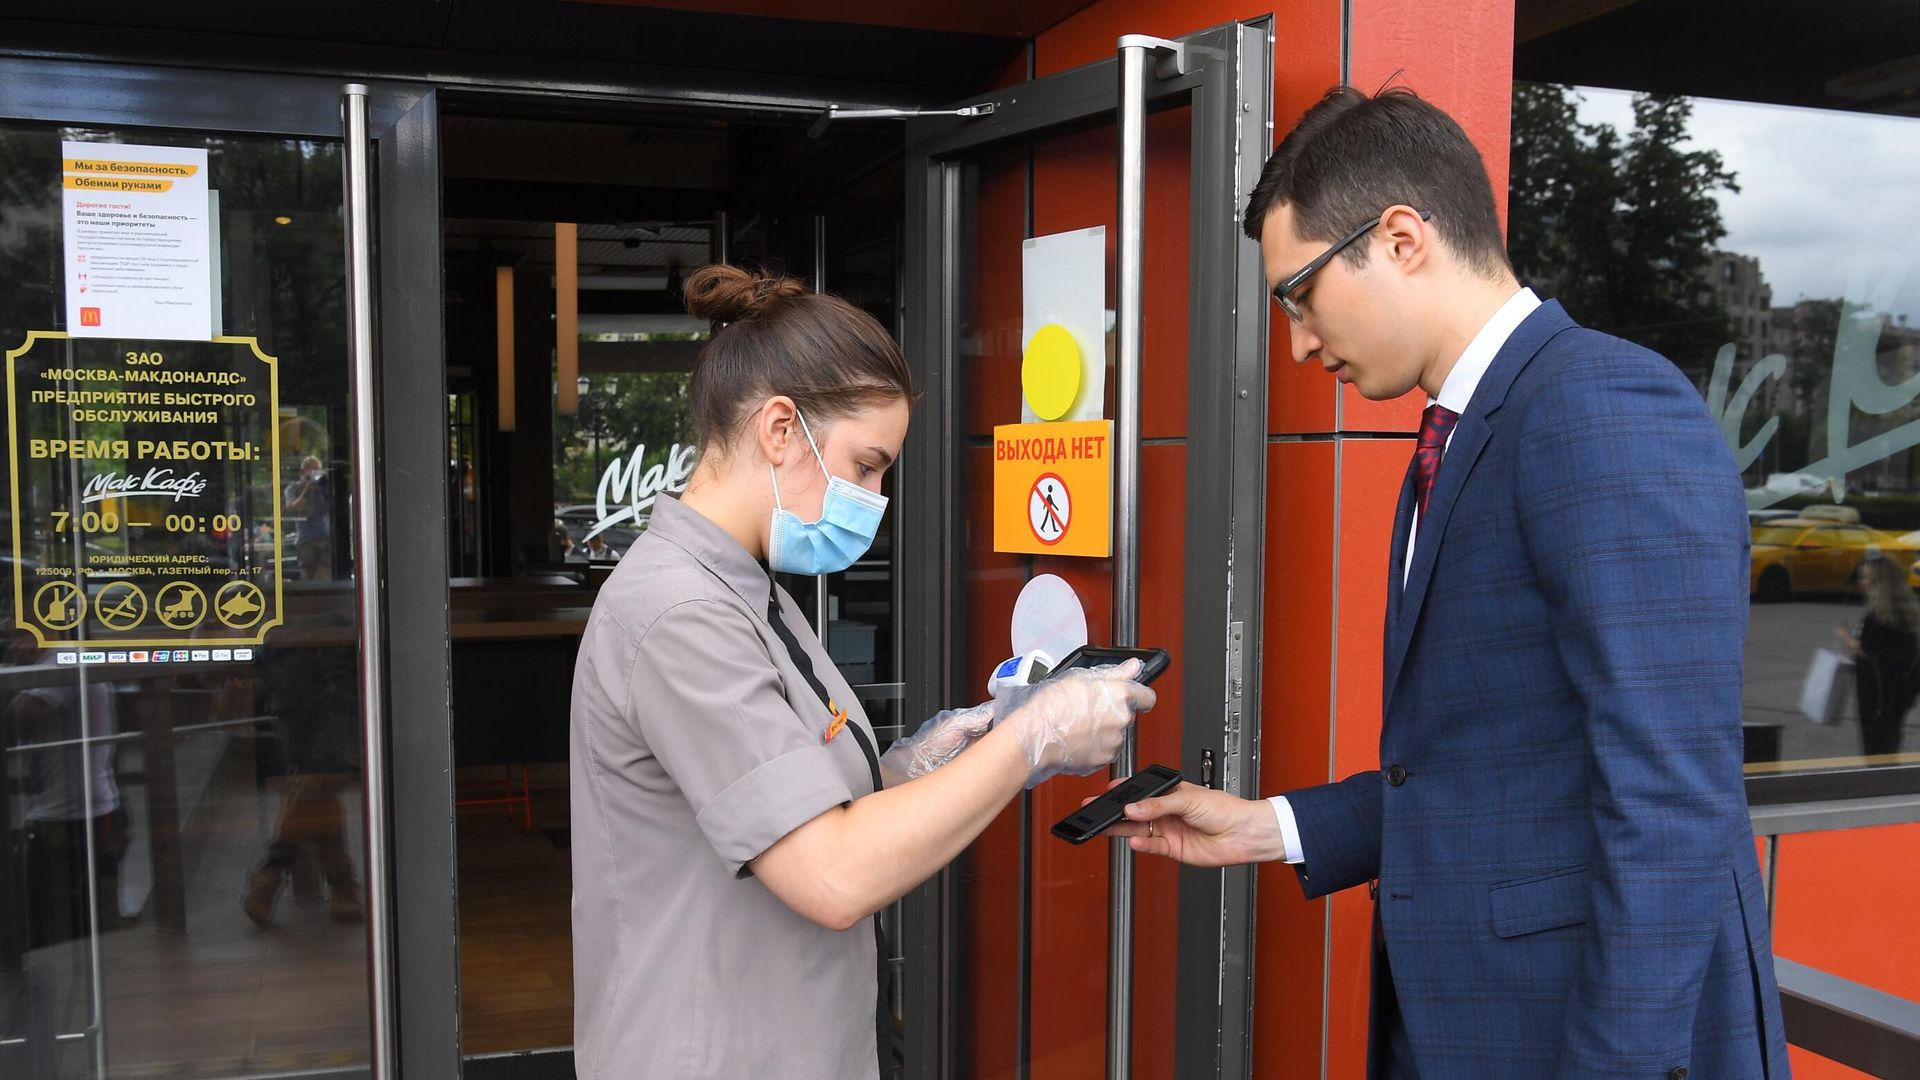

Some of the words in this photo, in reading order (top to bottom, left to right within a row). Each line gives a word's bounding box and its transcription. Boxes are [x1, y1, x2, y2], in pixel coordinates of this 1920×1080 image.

[75, 162, 93, 170] Мы
[96, 163, 108, 171] за
[110, 164, 189, 175] безопасность.
[75, 178, 119, 188] Обеими
[121, 181, 161, 190] руками
[139, 213, 188, 221] безопасность
[126, 352, 163, 366] ЗАО
[40, 369, 246, 386] «МОСКВА-МАКДОНАЛДС»
[32, 390, 160, 406] ПРЕДПРИЯТИЕ
[163, 393, 256, 407] БЫСТРОГО
[72, 409, 218, 424] ОБСЛУЖИВАНИЯ
[30, 439, 130, 460] ВРЕМЯ
[137, 440, 260, 461] РАБОТЫ:
[997, 438, 1068, 465] ВЫХОДА
[1071, 436, 1106, 460] НЕТ
[51, 511, 120, 533] 7:00
[165, 514, 242, 533] 00:00
[90, 554, 169, 564] ЮРИДИЧЕСКИЙ
[171, 555, 209, 564] АДРЕС:
[35, 568, 75, 577] 125009,
[108, 568, 156, 576] МОСКВА,
[157, 566, 211, 575] ГАЗЕТНЫЙ
[252, 567, 262, 575] 17
